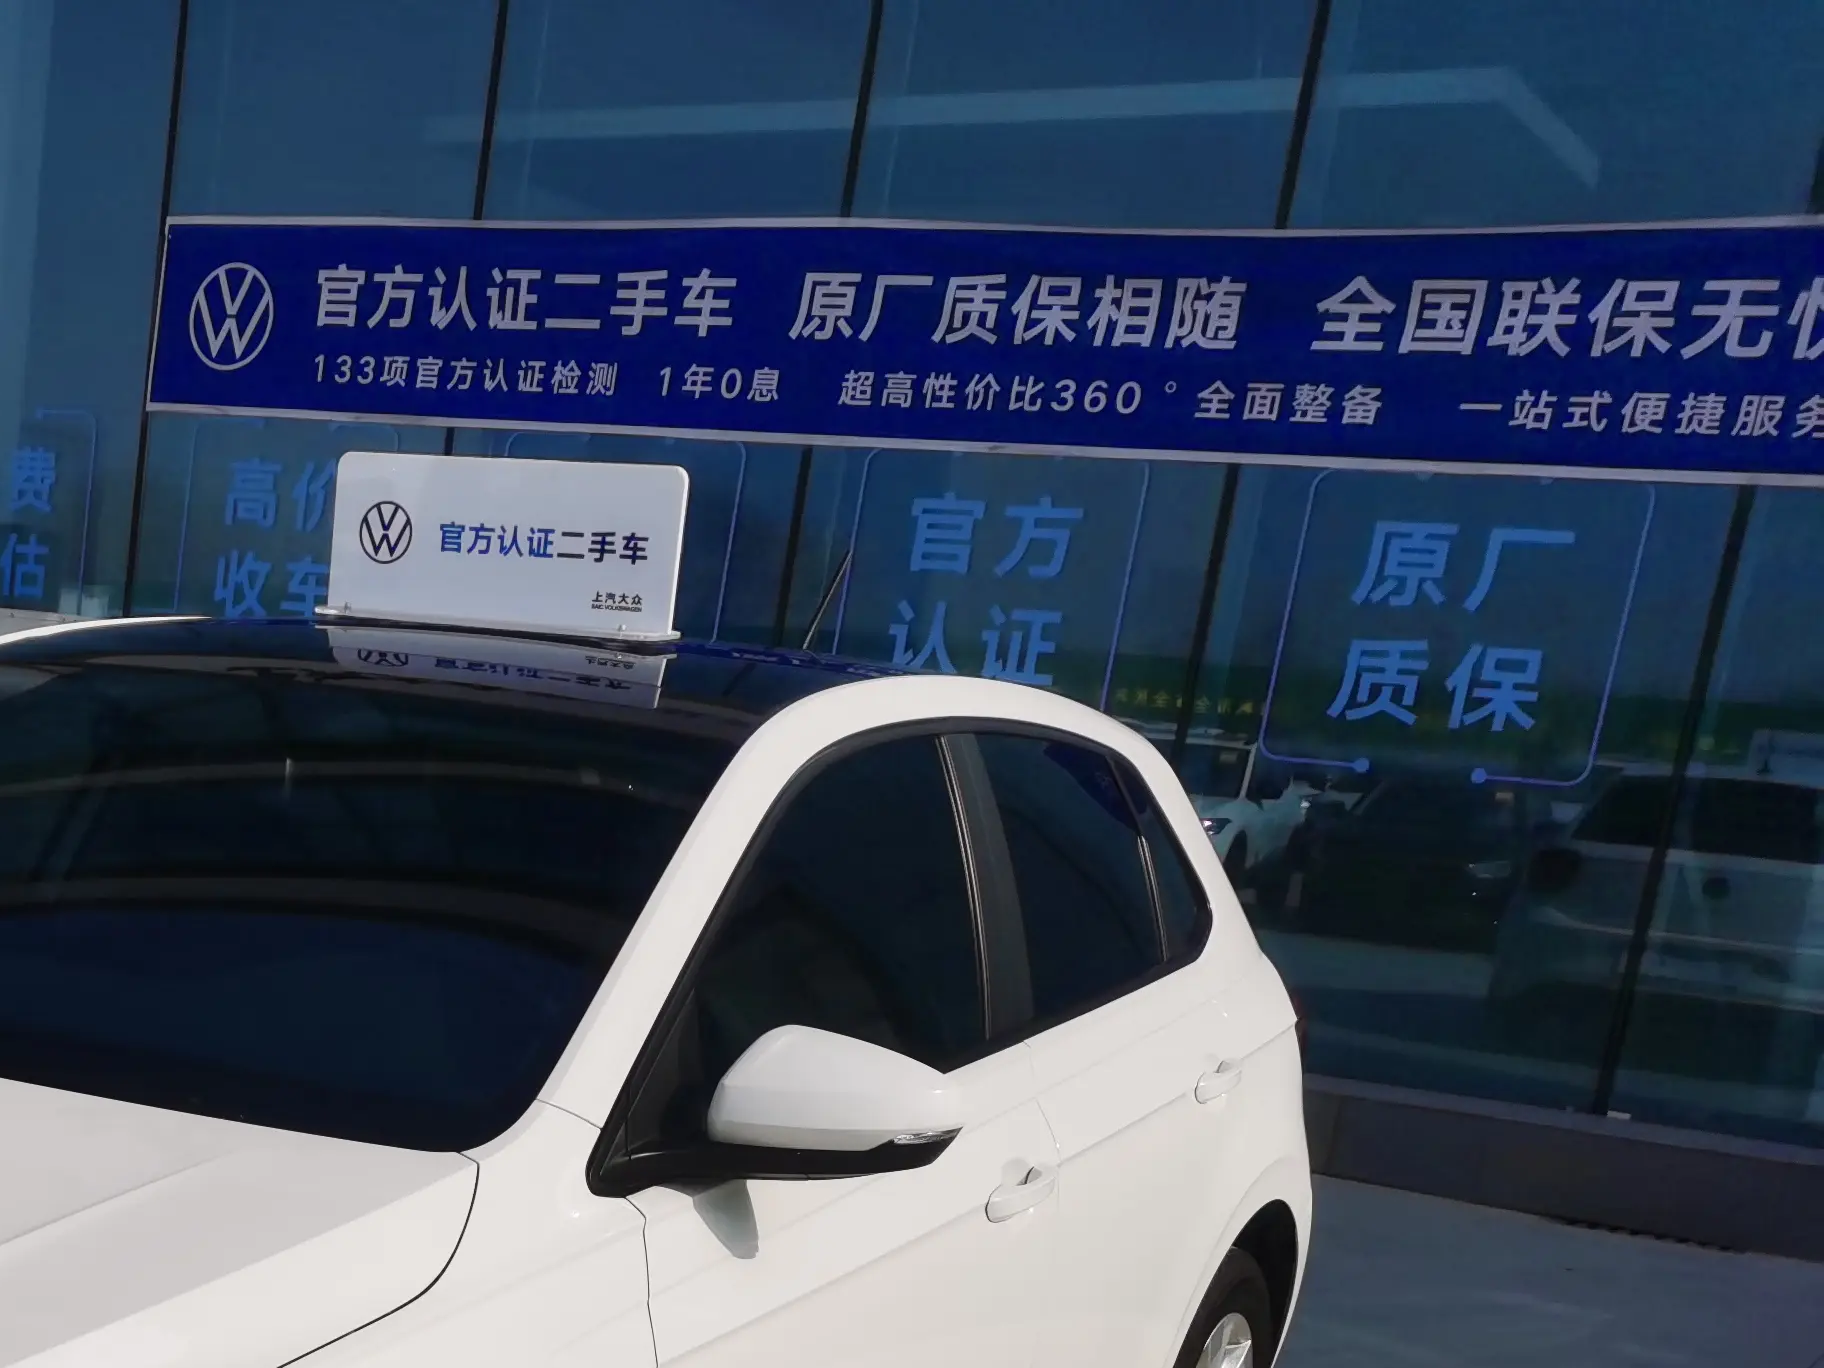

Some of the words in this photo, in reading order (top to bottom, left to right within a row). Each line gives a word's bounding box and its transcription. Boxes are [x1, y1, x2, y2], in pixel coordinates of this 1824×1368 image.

[312, 263, 739, 337] 官方认证二手车
[788, 272, 1248, 351] 原厂质保相随
[312, 353, 617, 398] 133项官方认证检测
[658, 363, 781, 403] 1年0息
[1458, 389, 1824, 439] 一站式便捷服务
[439, 521, 649, 565] 官方认证二手车
[910, 492, 1084, 578] 官方
[1351, 520, 1575, 612] 原厂
[214, 549, 330, 618] 收车
[591, 590, 643, 606] 上汽大众
[889, 600, 1063, 686] 认证
[1328, 637, 1546, 733] 质保
